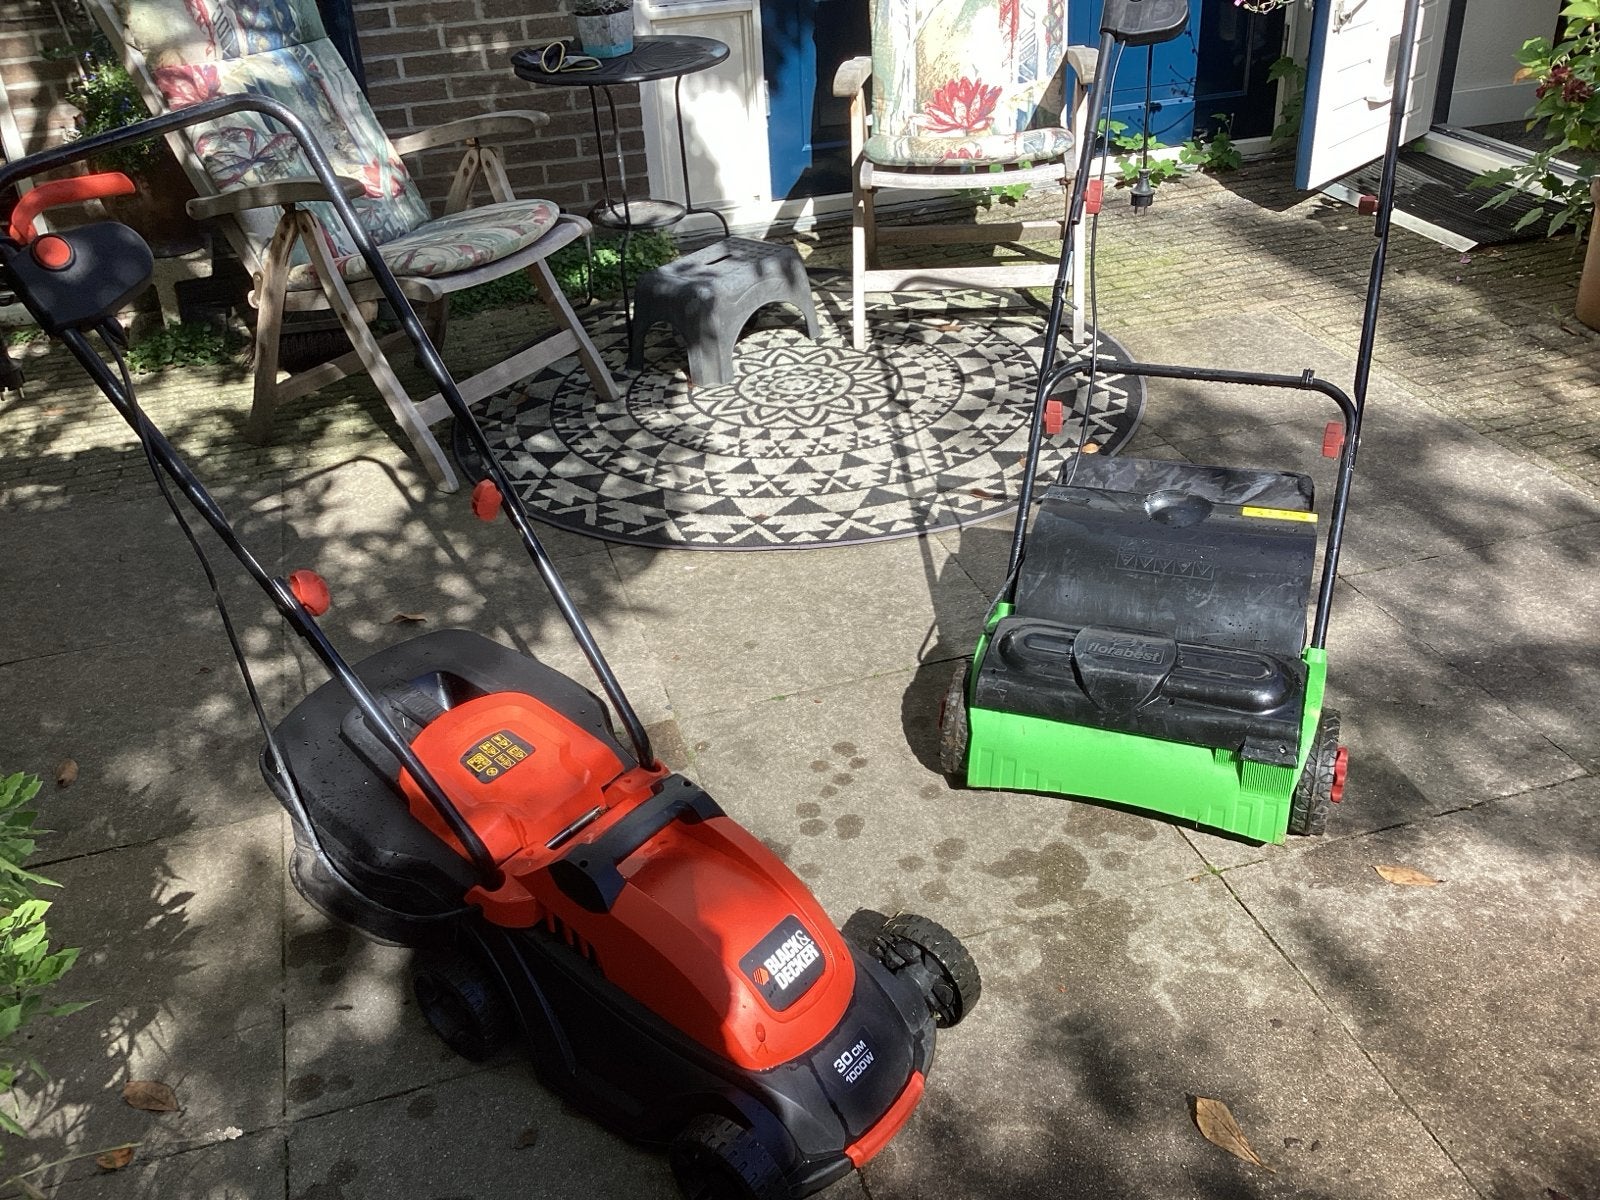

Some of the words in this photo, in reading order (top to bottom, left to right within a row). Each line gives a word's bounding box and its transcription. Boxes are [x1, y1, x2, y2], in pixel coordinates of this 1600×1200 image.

[774, 943, 820, 990] DECKER
[833, 1051, 853, 1074] 30
[851, 1039, 867, 1057] CM
[845, 1051, 874, 1083] 1000W
